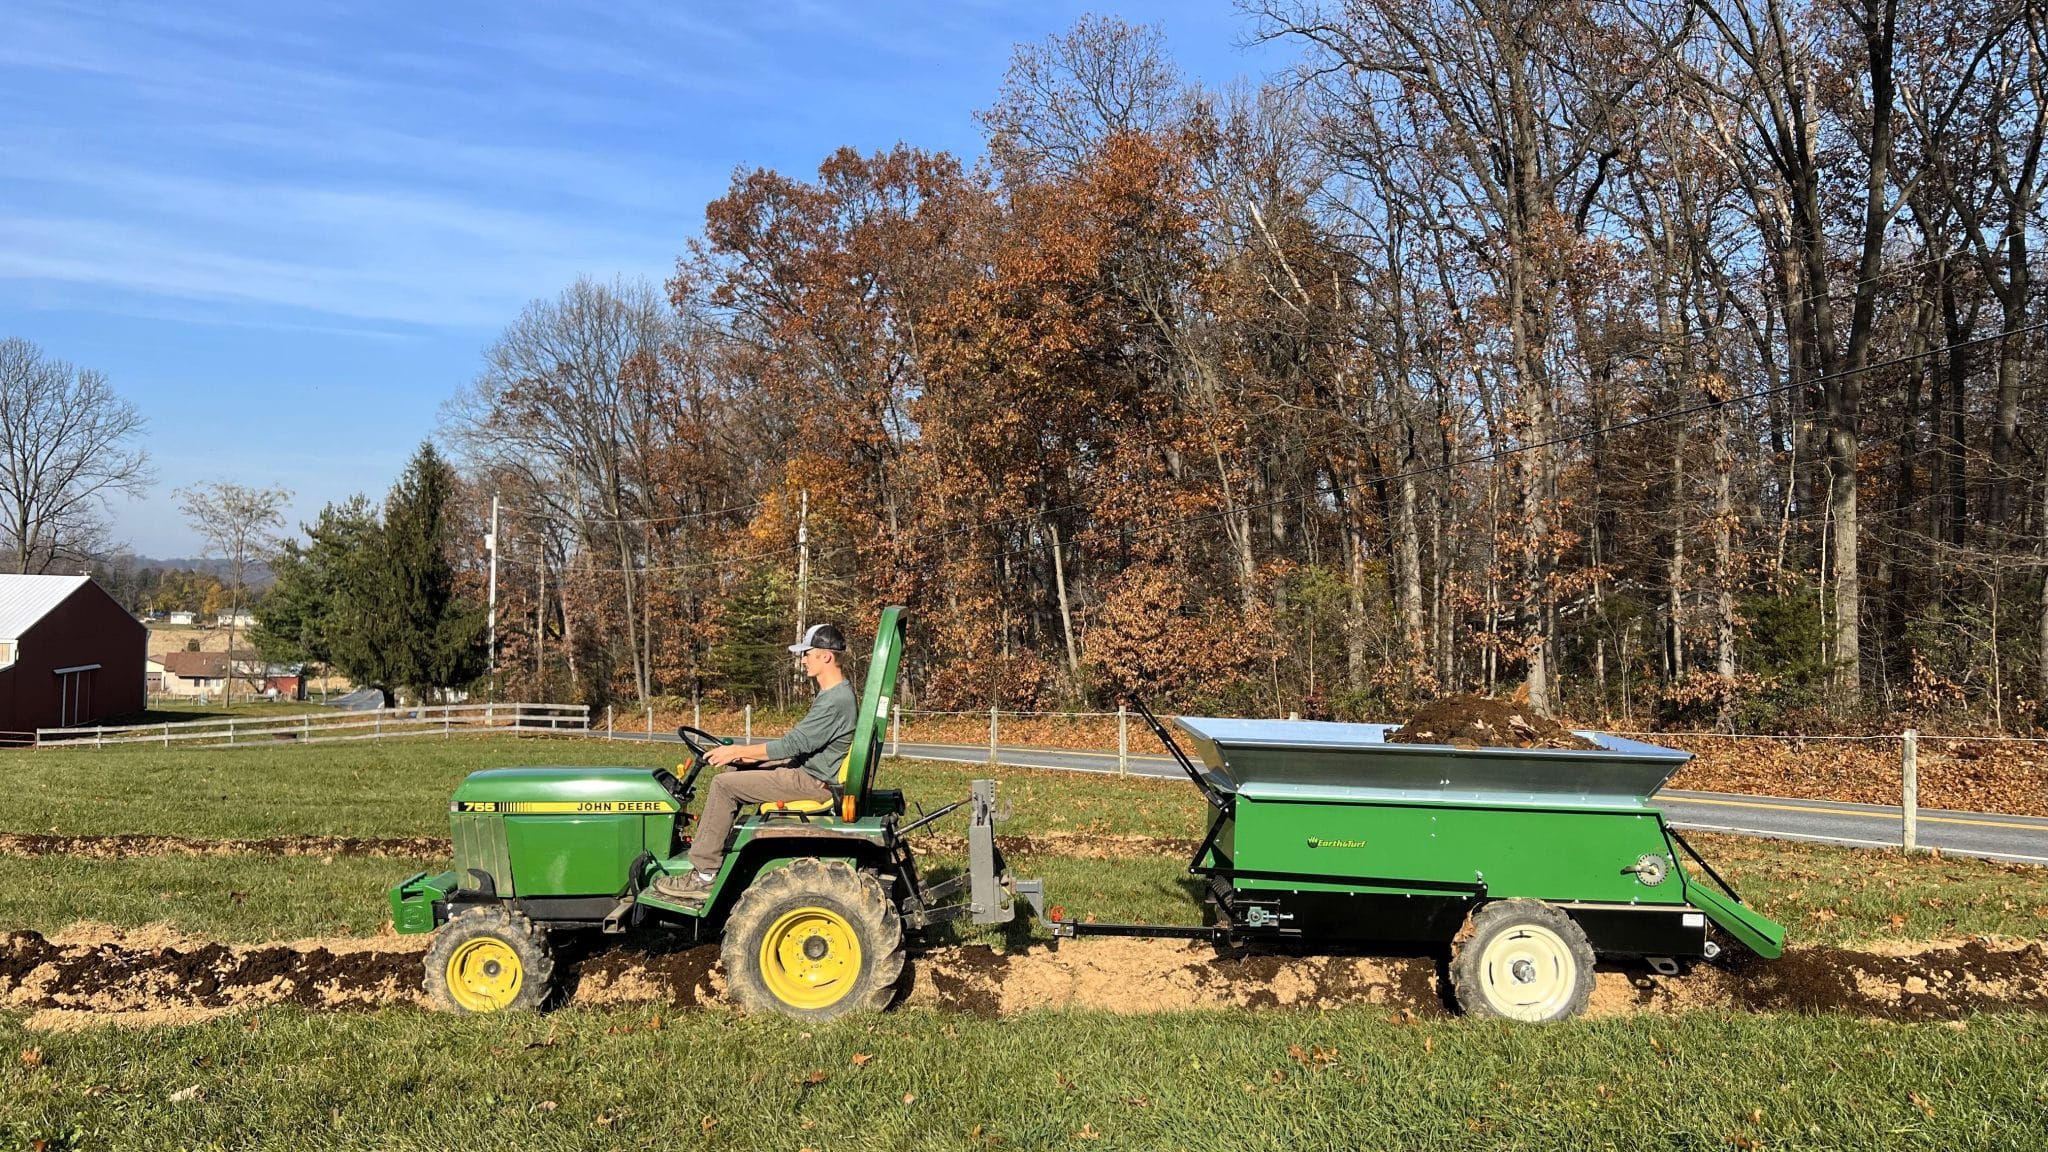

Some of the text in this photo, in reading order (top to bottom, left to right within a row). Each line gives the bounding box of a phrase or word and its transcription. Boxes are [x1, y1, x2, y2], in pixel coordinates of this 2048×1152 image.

[463, 802, 496, 812] 755
[577, 802, 661, 811] JOHN DEERE
